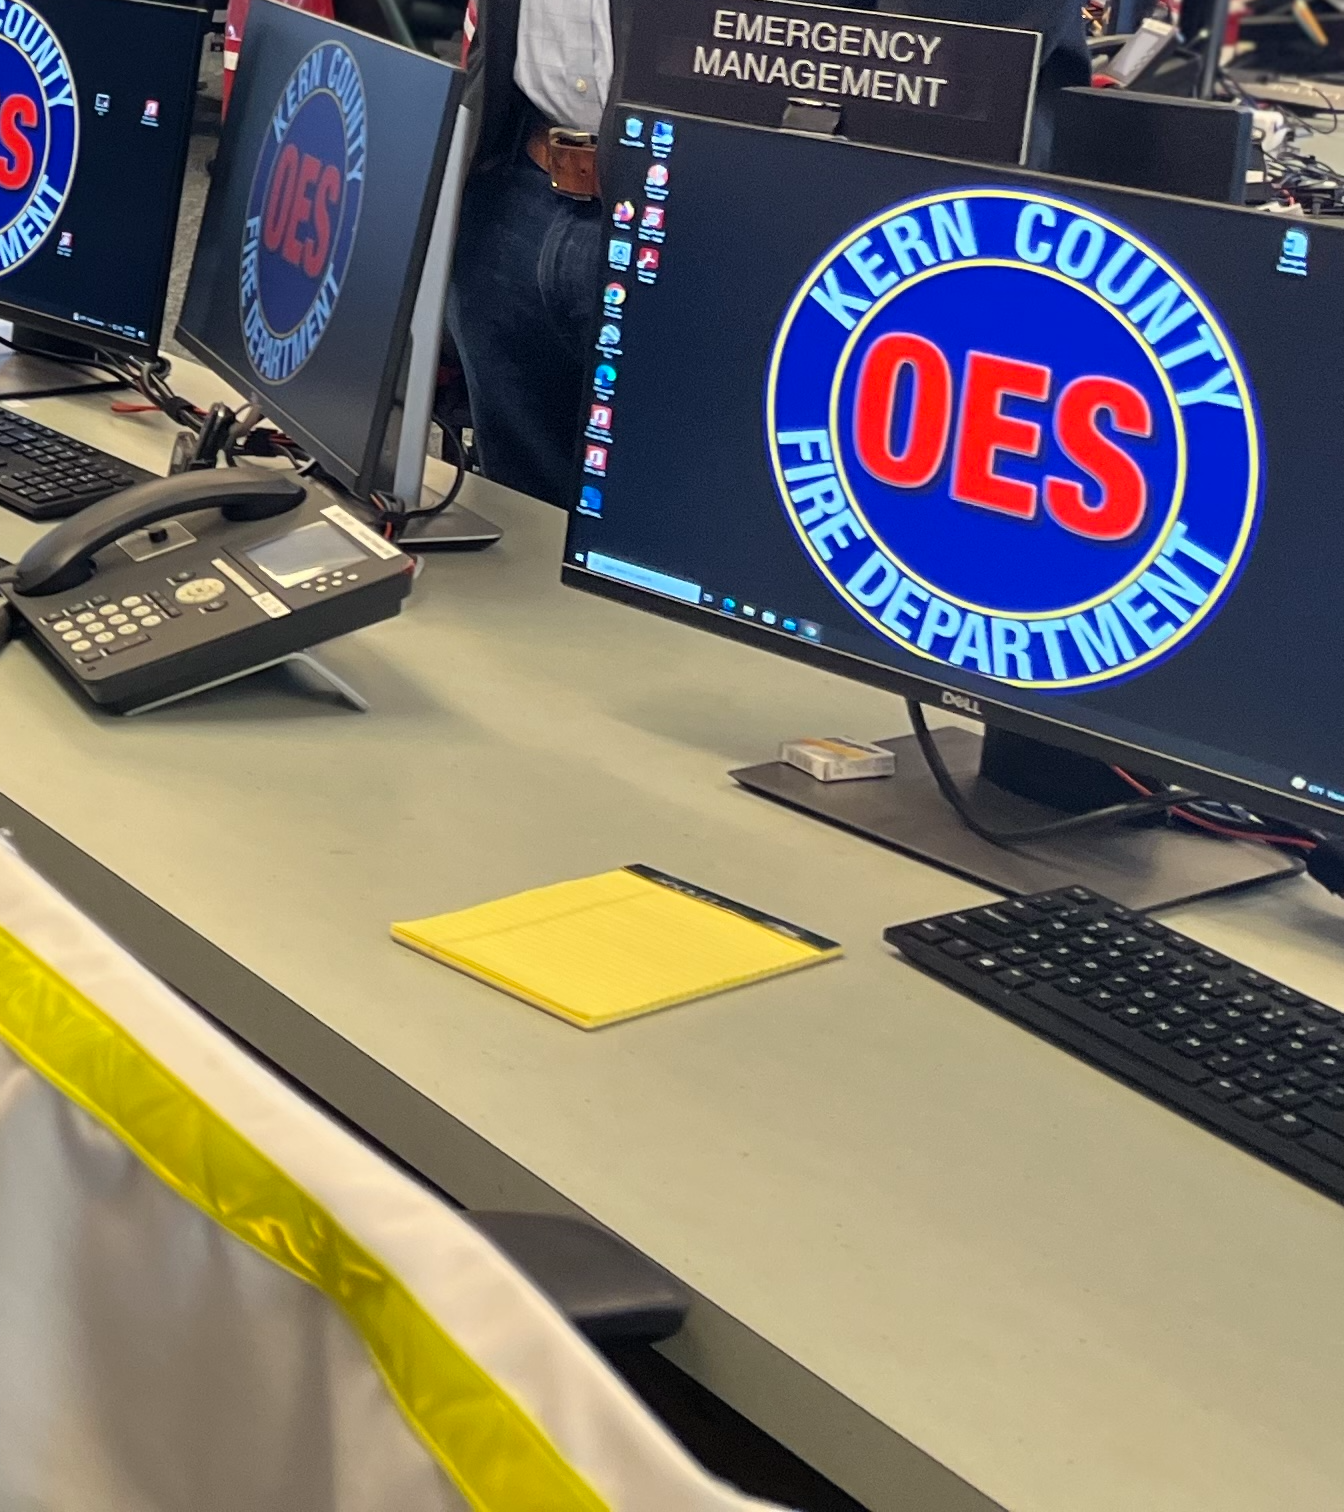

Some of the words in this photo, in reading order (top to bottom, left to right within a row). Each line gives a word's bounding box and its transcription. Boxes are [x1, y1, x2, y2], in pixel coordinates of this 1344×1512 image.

[692, 46, 948, 108] MANAGEMENT
[712, 9, 942, 65] EMERGENCY
[272, 52, 321, 143] KERN
[328, 46, 365, 183] COUNTY
[241, 216, 261, 307] FIRE
[262, 143, 342, 278] OES
[244, 263, 341, 379] DEPARTMENT
[809, 199, 977, 331] KERN
[1014, 202, 1242, 413] COUNTY
[852, 330, 1152, 542] OES
[777, 429, 864, 562] FIRE
[846, 519, 1228, 681] DEPARTMENT
[942, 691, 982, 716] DELL
